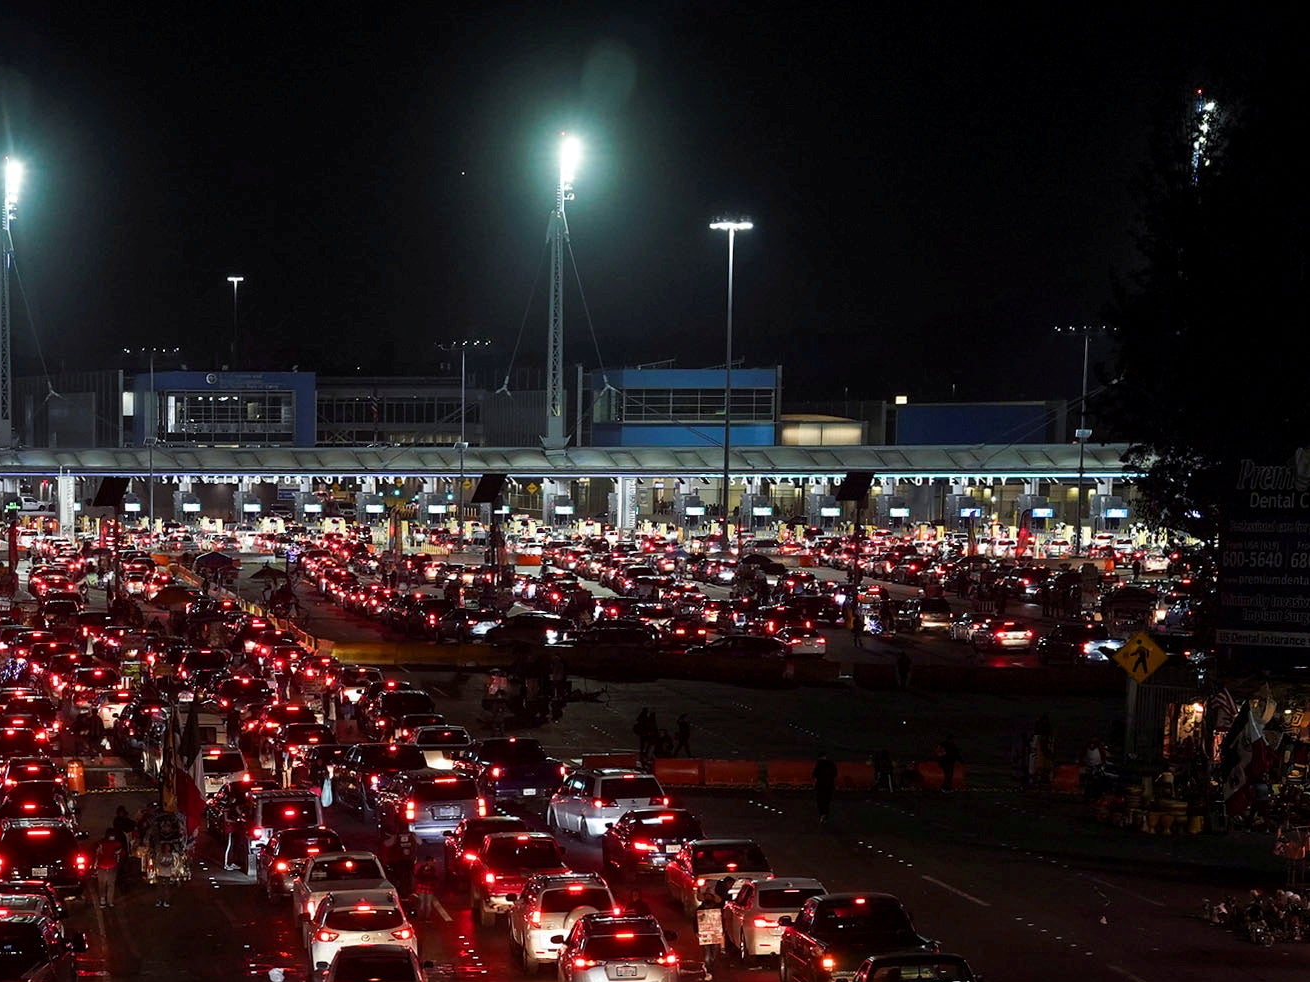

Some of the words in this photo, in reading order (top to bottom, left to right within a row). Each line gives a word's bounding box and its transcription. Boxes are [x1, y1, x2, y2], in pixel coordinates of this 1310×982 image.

[162, 476, 192, 484] SAN
[202, 476, 262, 484] YSIDRO
[273, 476, 314, 484] PORT
[326, 476, 344, 484] OF
[356, 476, 407, 484] ENTRY
[730, 477, 762, 486] SAN
[775, 477, 842, 486] YSIDRO
[915, 478, 935, 486] OF
[948, 478, 1008, 486] ENTRY
[1250, 492, 1295, 508] Dental
[1222, 552, 1282, 568] 600-5640
